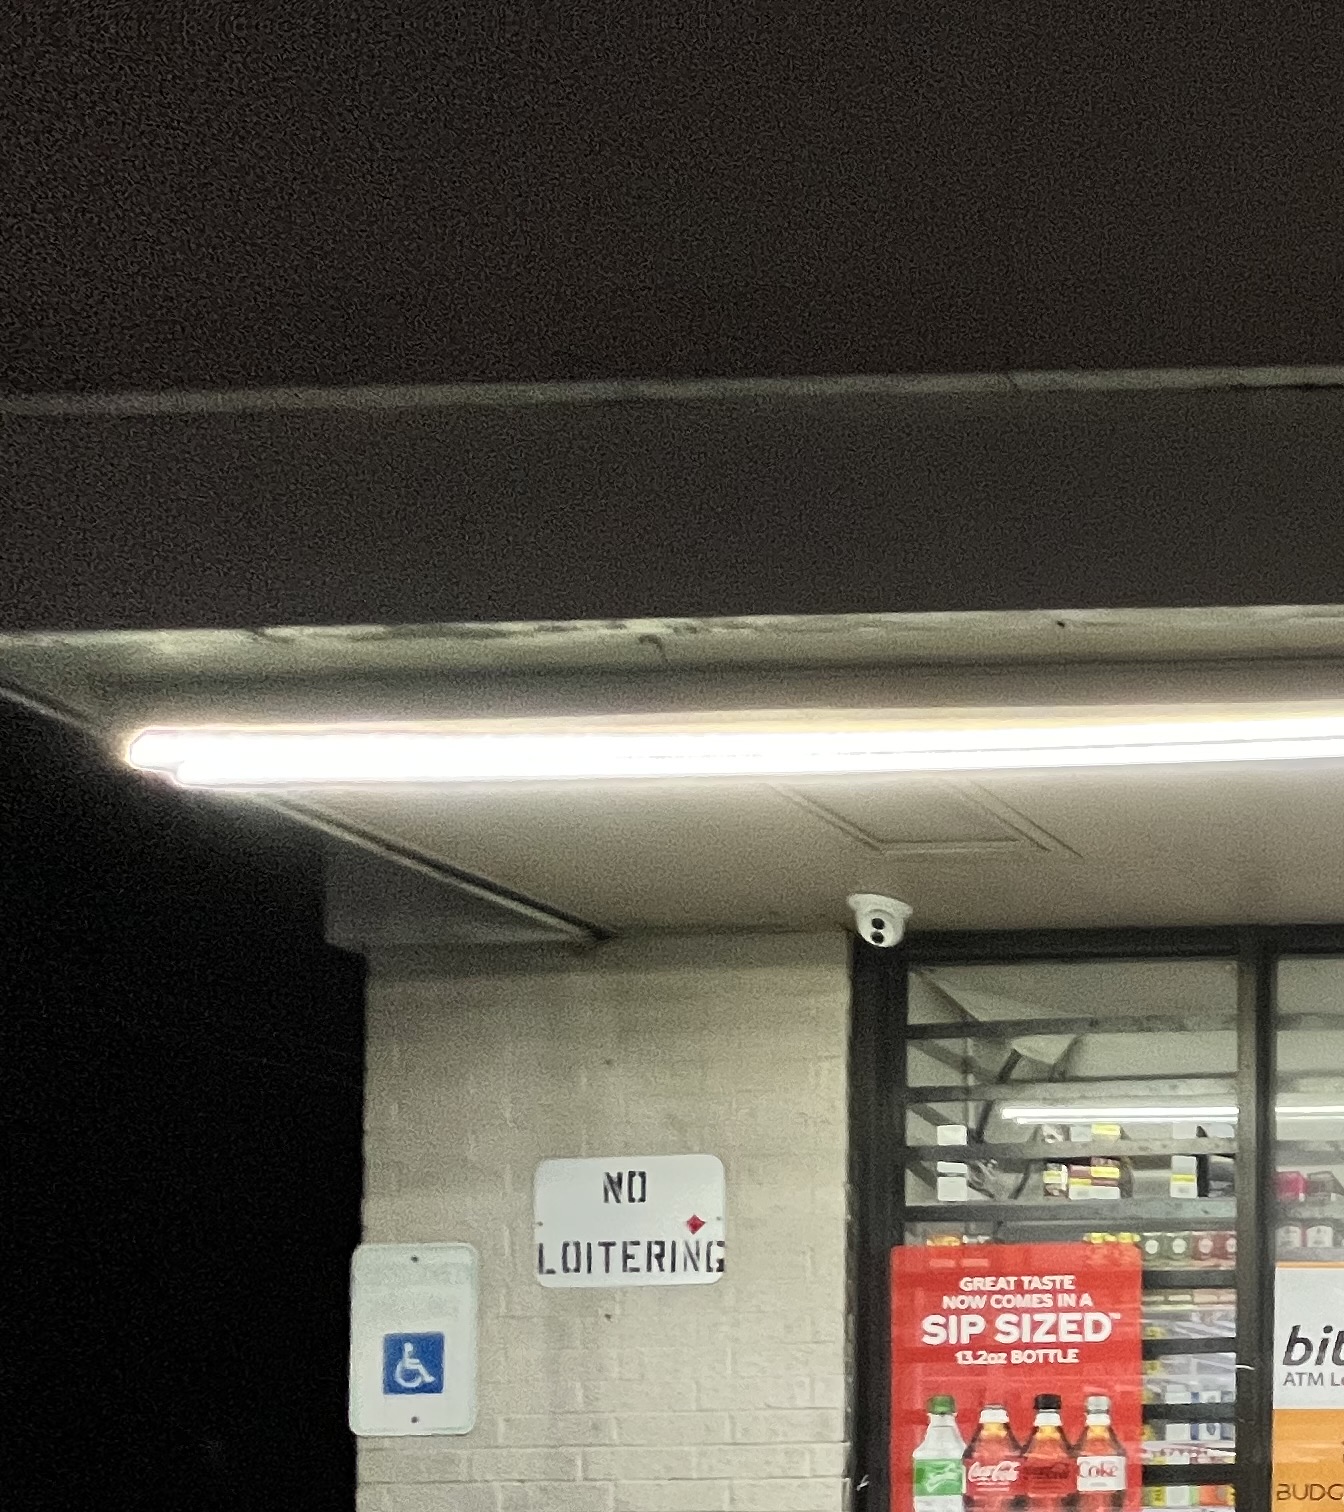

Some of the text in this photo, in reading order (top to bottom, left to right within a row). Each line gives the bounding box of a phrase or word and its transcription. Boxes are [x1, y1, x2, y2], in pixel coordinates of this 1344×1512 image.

[603, 1170, 647, 1203] NO
[538, 1239, 726, 1275] LOITERING
[959, 1275, 1076, 1291] GREAT TASTE
[942, 1293, 1093, 1309] NOW COMES IN A
[922, 1314, 986, 1345] SIP
[955, 1349, 1080, 1365] 13.2oz BOTTLE
[1283, 1371, 1324, 1387] ATM
[1078, 1460, 1118, 1478] Coke
